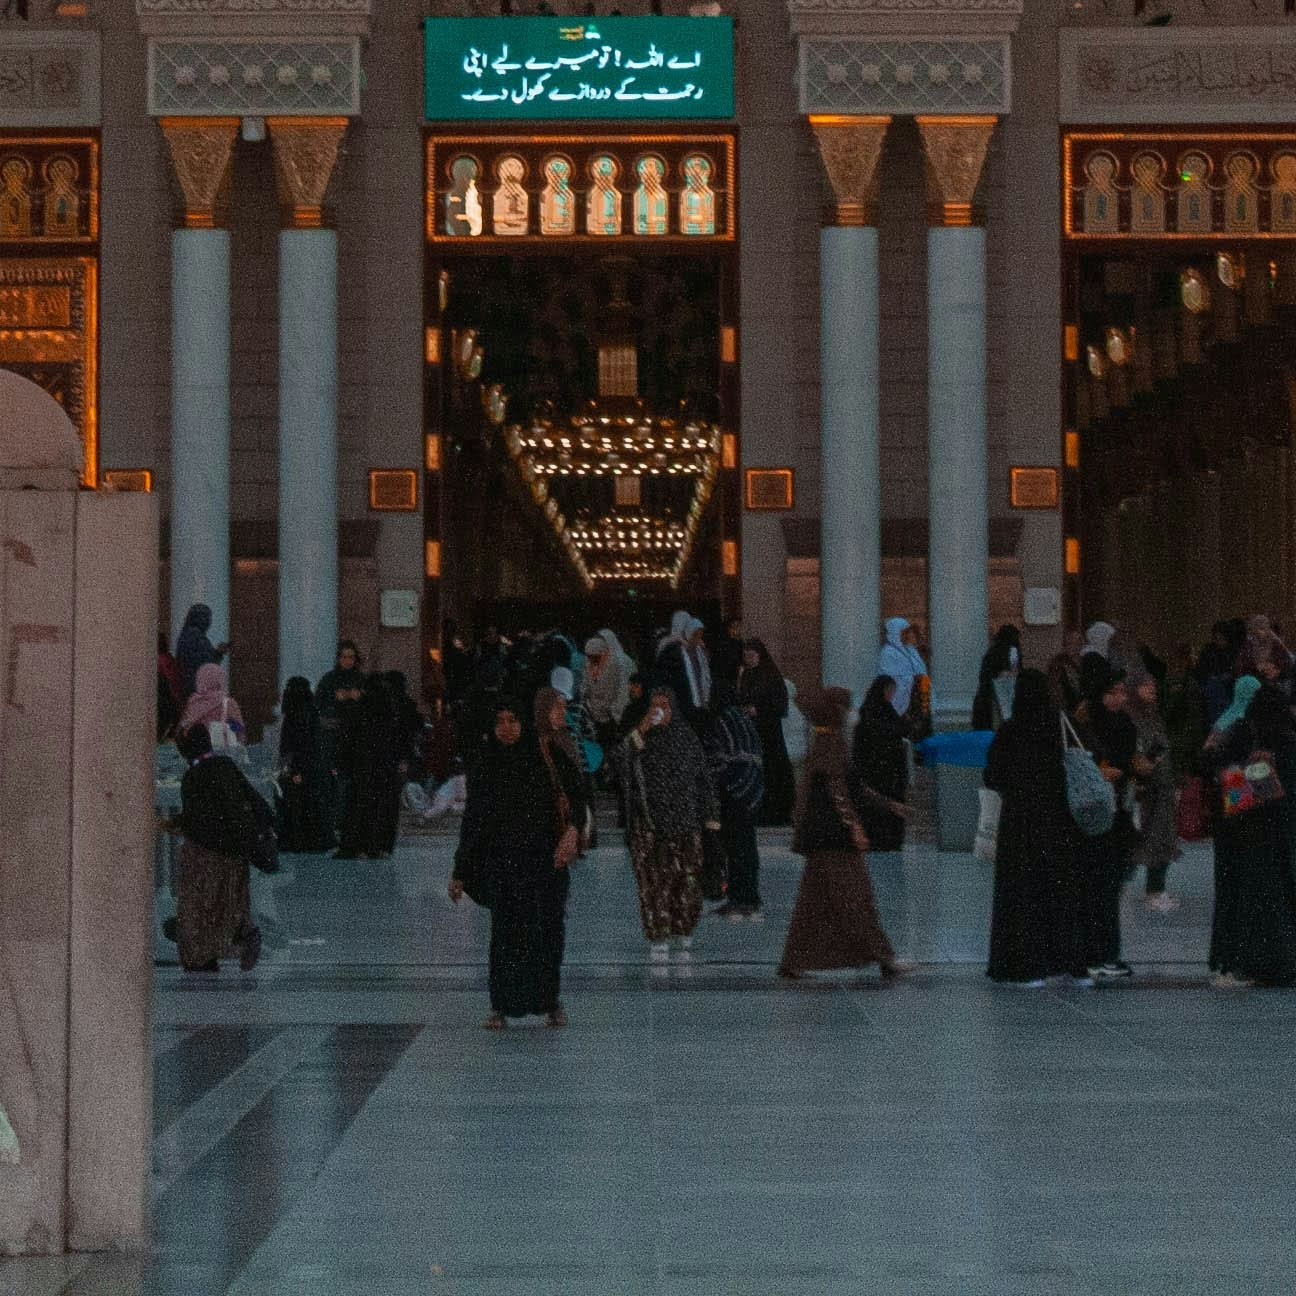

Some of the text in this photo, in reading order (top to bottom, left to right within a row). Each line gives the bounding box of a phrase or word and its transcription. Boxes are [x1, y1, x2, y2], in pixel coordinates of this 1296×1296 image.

[462, 47, 488, 78] اپنی
[524, 49, 599, 71] میرے
[667, 51, 701, 69] اے
[548, 82, 611, 101] دروازے
[642, 83, 704, 101] رحمت
